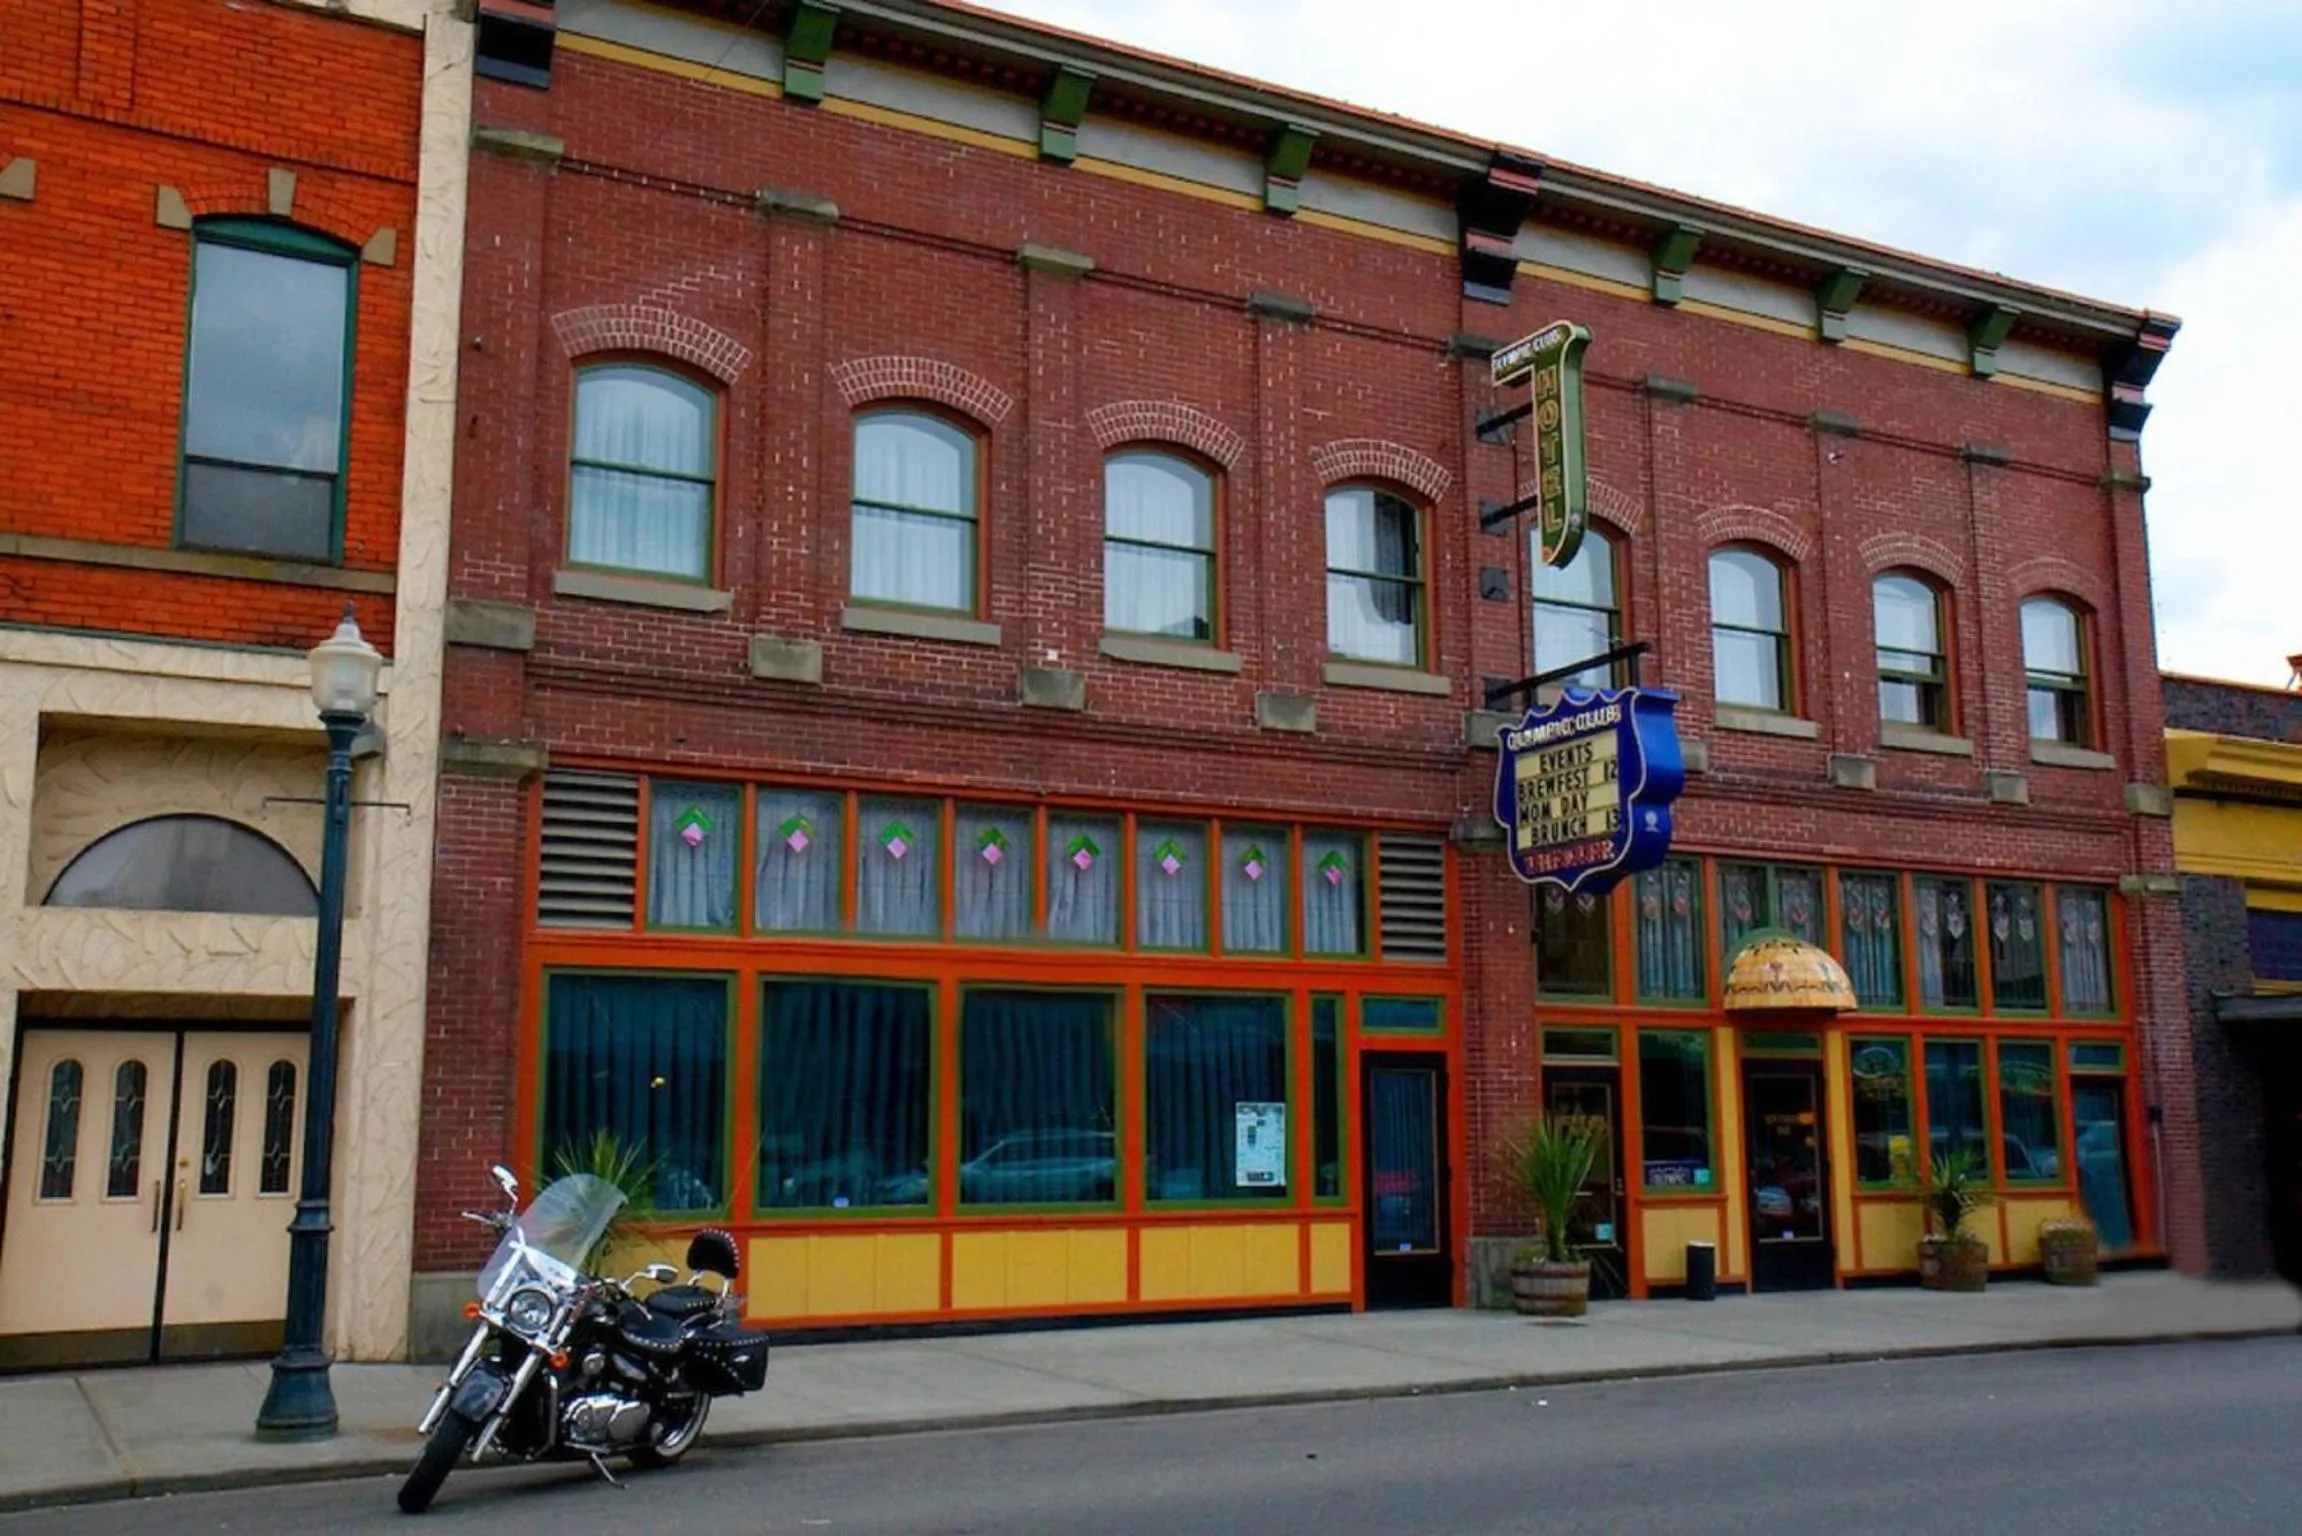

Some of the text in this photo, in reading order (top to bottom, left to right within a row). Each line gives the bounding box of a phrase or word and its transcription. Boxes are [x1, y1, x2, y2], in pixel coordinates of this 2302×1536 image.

[1536, 365, 1562, 533] HOTEL
[1540, 742, 1593, 775] EVENTS
[1518, 759, 1618, 800] BREWFEST 12
[1561, 790, 1589, 816] DAY
[1531, 808, 1620, 845] BRUNCH 13
